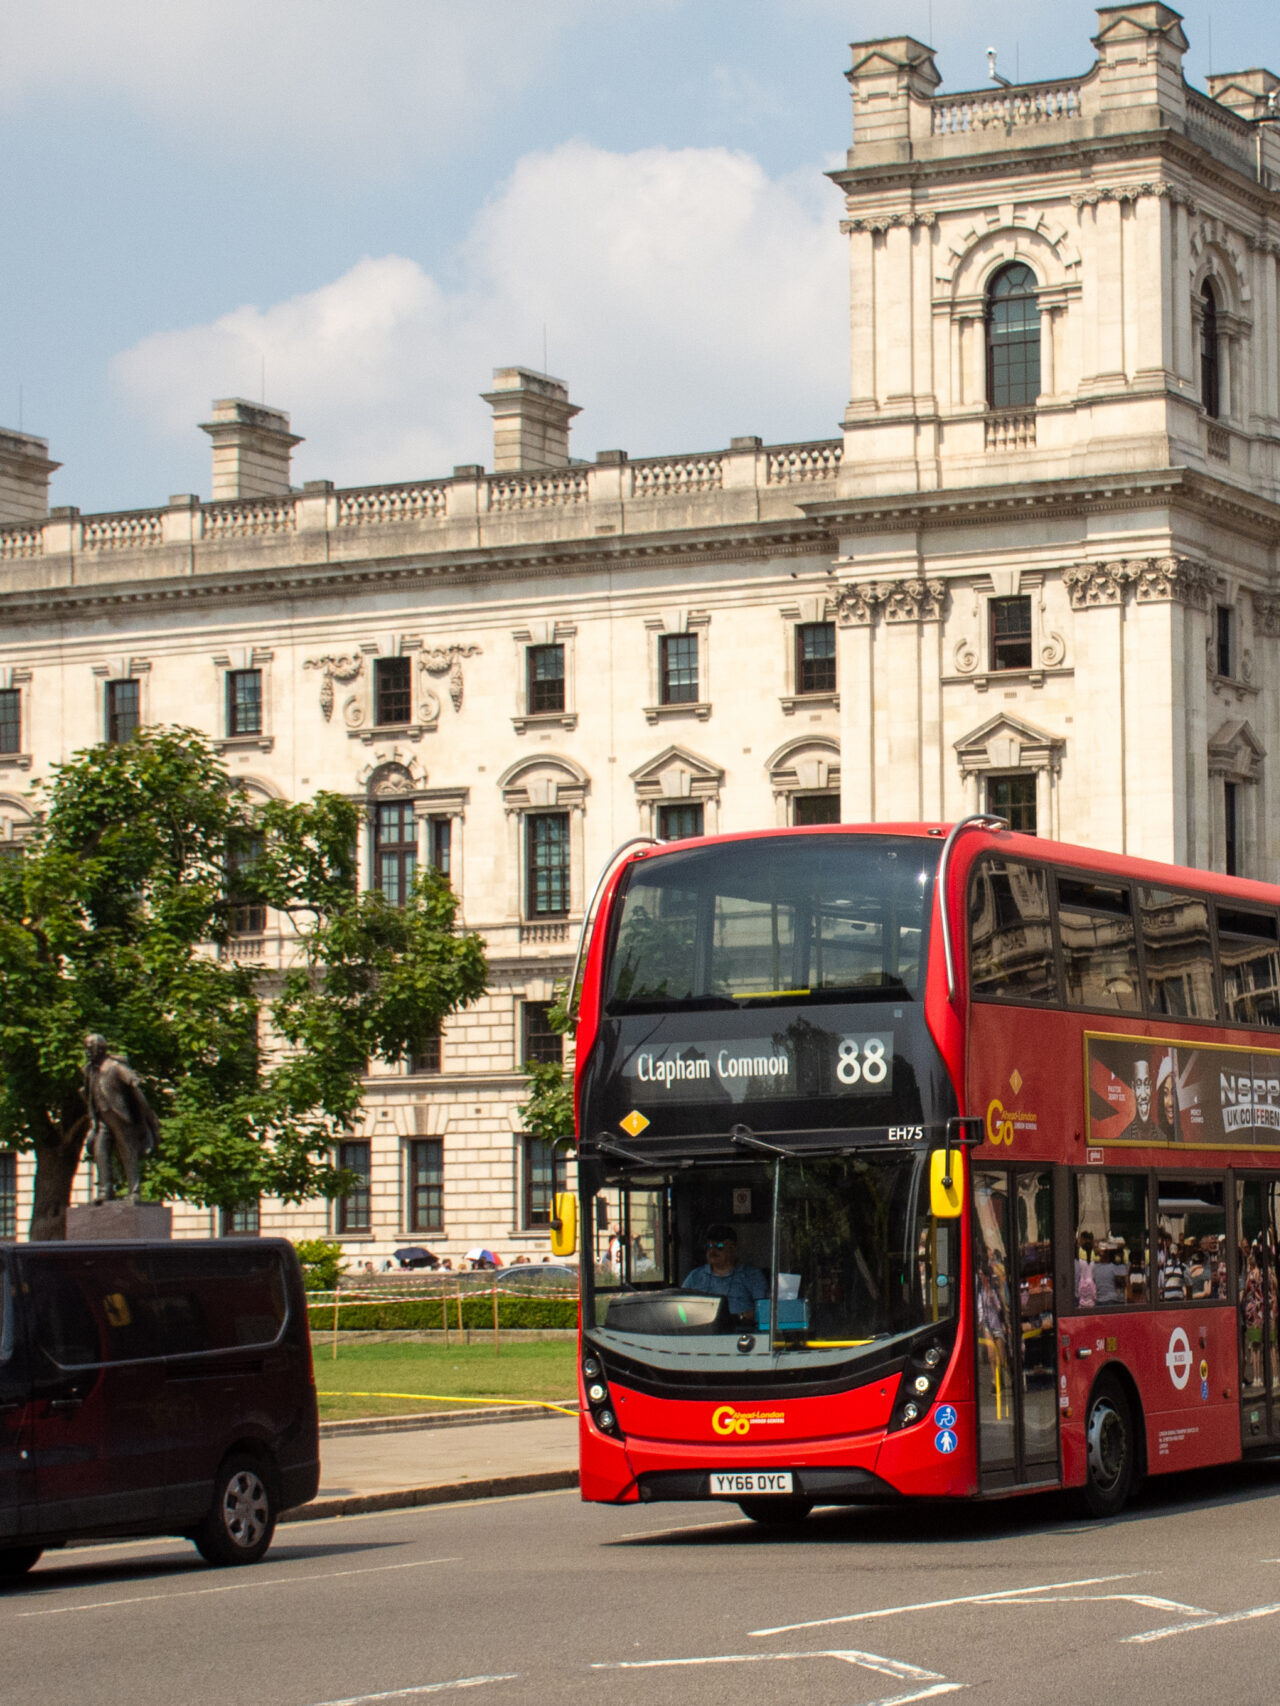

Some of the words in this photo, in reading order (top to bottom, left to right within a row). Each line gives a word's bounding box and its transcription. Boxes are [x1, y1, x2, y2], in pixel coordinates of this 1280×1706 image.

[637, 1051, 711, 1089] Clapham
[717, 1050, 789, 1078] Common
[836, 1038, 888, 1084] 88
[987, 1099, 1014, 1146] Go
[1227, 1108, 1238, 1126] UK
[888, 1126, 923, 1140] EH75
[712, 1405, 750, 1435] Go
[717, 1476, 753, 1490] YY66
[757, 1475, 786, 1490] OYC
